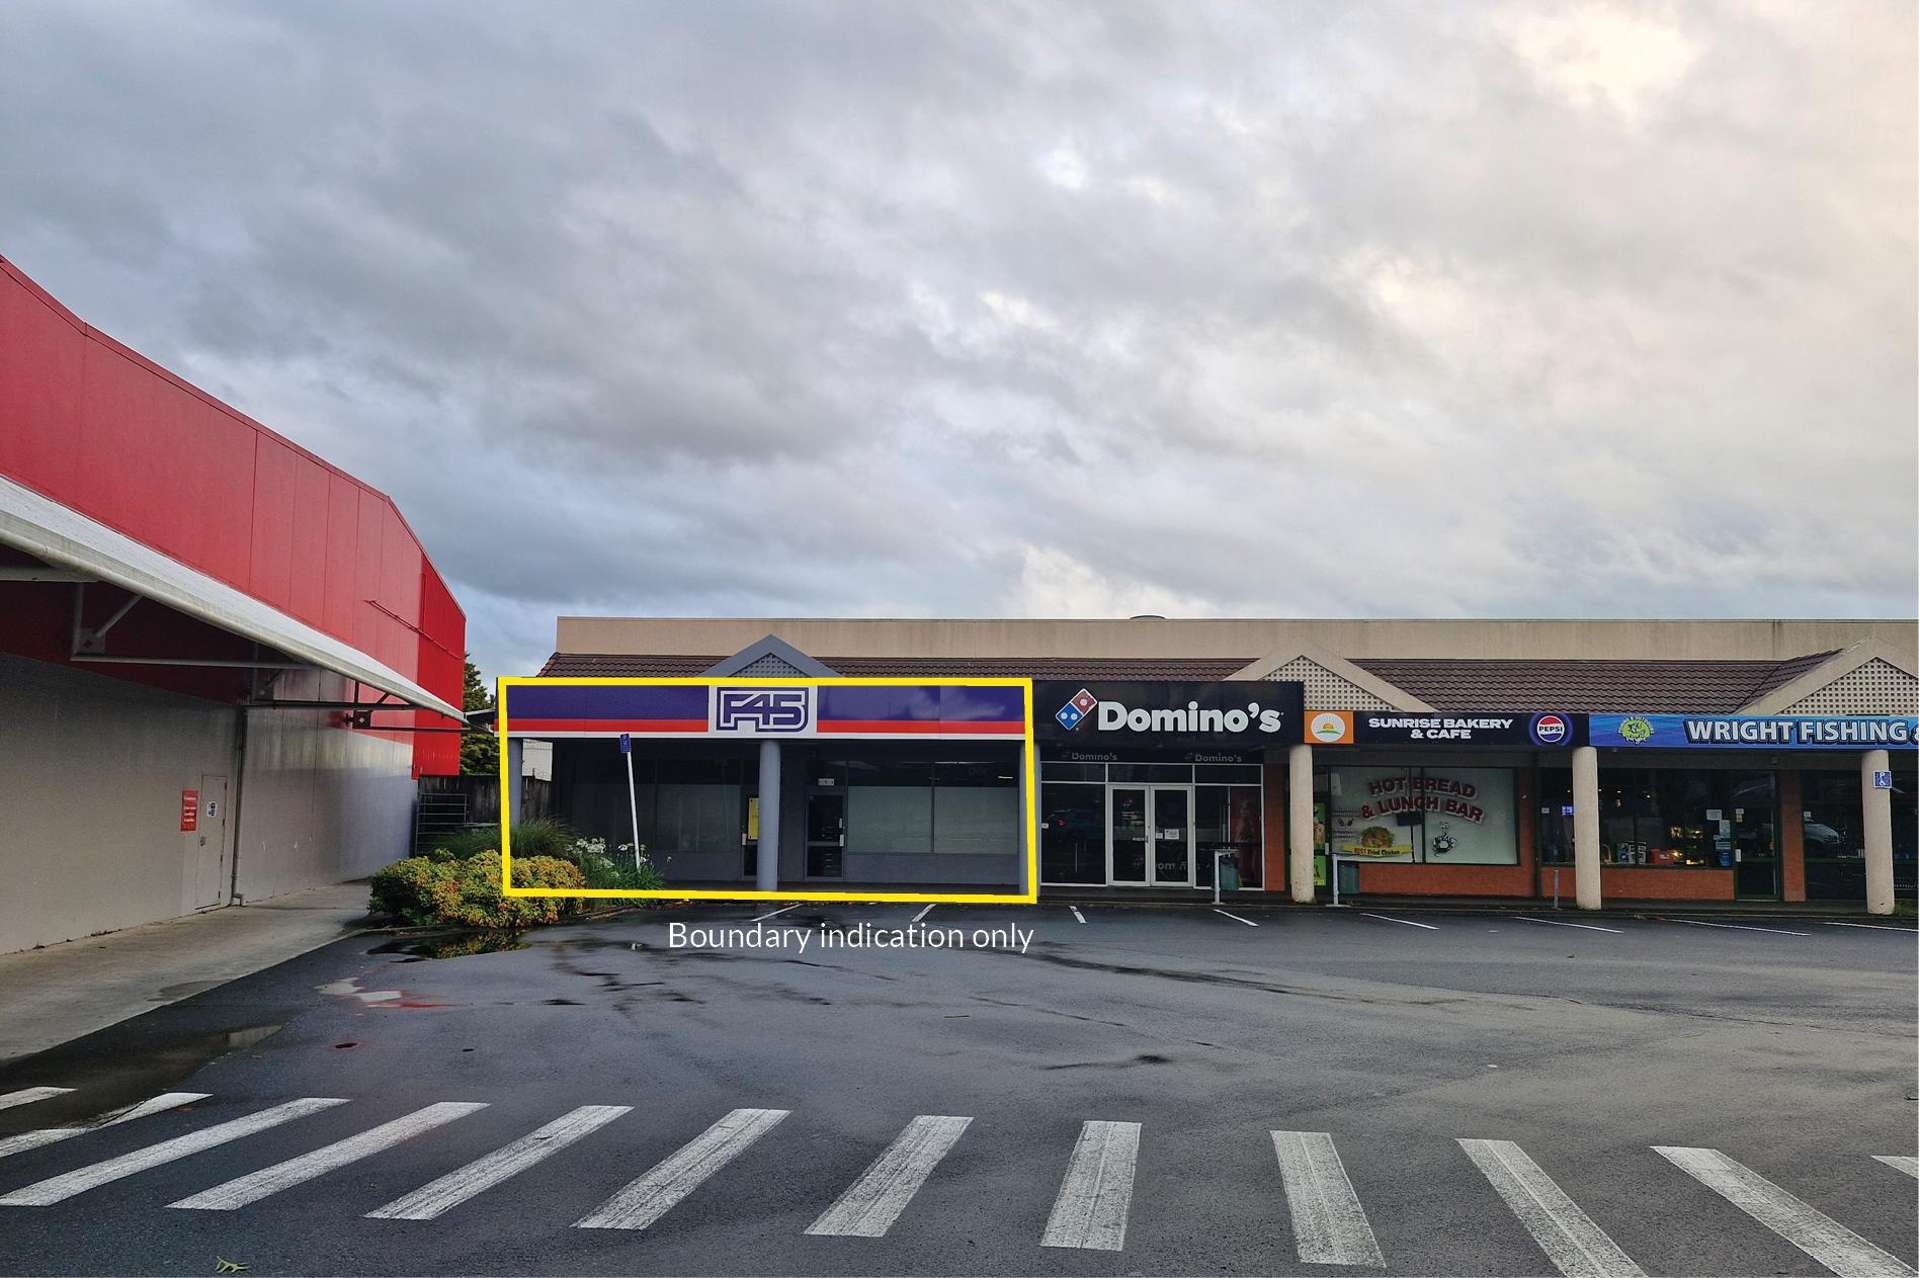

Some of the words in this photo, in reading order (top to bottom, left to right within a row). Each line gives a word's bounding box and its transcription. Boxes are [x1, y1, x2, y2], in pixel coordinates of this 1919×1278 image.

[718, 688, 807, 731] F45
[1098, 701, 1282, 733] Domino's
[1368, 718, 1441, 729] SUNRISE
[1443, 718, 1514, 729] BAKERY
[1538, 725, 1563, 733] PEPSI
[1687, 721, 1794, 741] WRIGHT
[1800, 721, 1907, 742] FISHING
[1410, 729, 1423, 740] &
[1426, 729, 1472, 740] CAFE
[1071, 752, 1118, 762] Domino's
[1194, 753, 1242, 763] Domino's
[1368, 778, 1407, 796] HOT
[1412, 779, 1478, 800] BREAD
[1361, 806, 1377, 821] &
[1377, 797, 1439, 817] LUNCH
[1445, 800, 1485, 825] BAR
